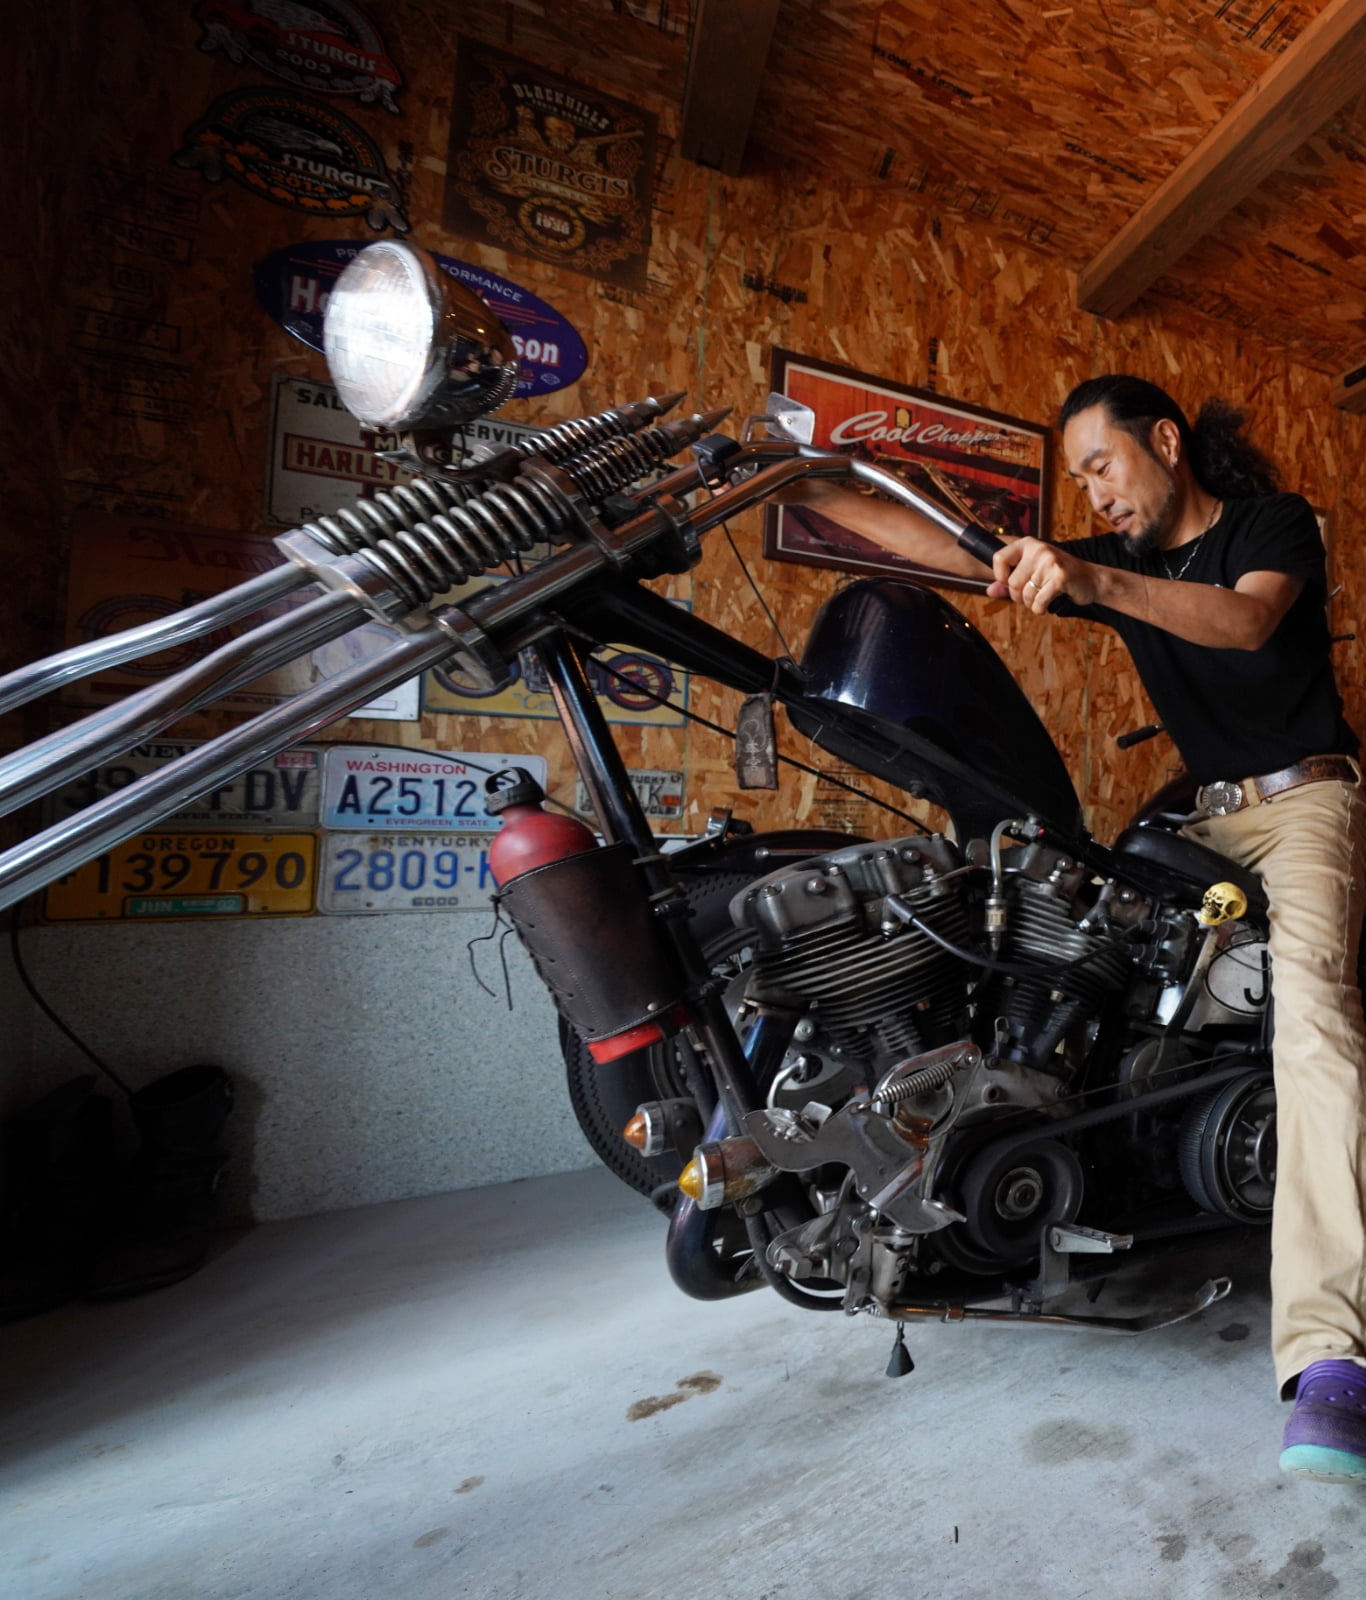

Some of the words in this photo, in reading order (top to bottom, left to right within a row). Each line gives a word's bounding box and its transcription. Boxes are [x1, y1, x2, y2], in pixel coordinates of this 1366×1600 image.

[287, 31, 377, 73] STURGIS
[280, 152, 380, 190] STURGIS
[484, 144, 632, 200] STURGIS
[830, 411, 921, 444] Cool
[916, 423, 1010, 445] Chopper
[346, 760, 468, 775] WASHINGTON
[385, 817, 452, 826] EVERGREEN
[458, 819, 489, 827] STATE
[143, 837, 236, 851] OREGON
[382, 837, 493, 847] KENTUCKY
[334, 849, 500, 891] 2809-K
